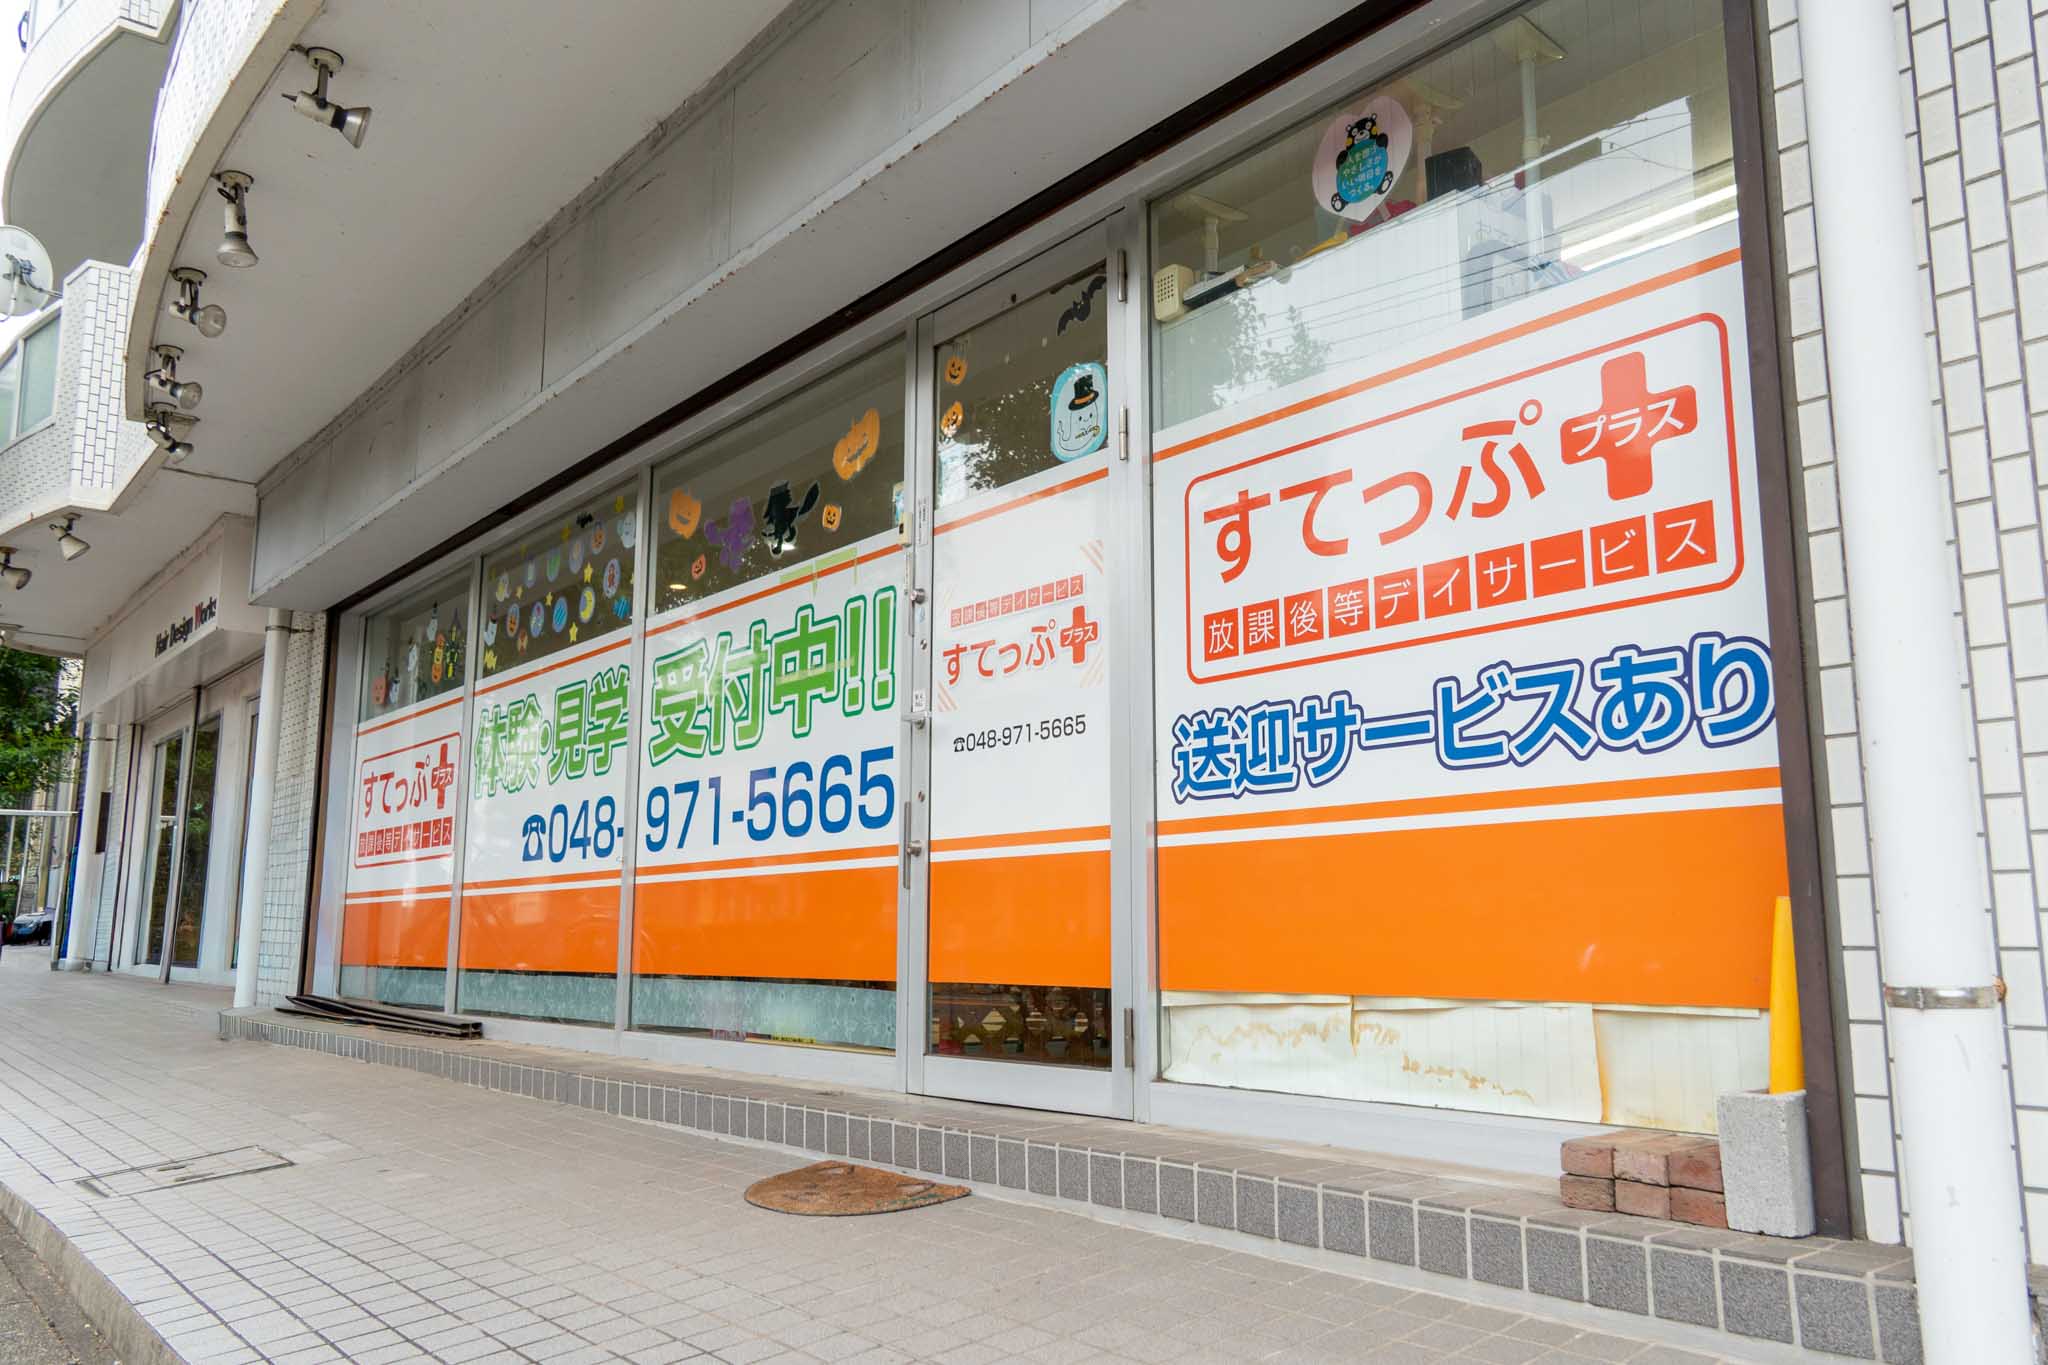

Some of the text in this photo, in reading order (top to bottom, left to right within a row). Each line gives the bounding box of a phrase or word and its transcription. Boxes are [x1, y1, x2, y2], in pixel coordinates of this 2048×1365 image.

[1203, 398, 1685, 583] すてっぷ プラス
[1206, 515, 1710, 658] 放課後等デイサービス
[943, 618, 1096, 685] すてっぷ プラス
[474, 664, 630, 799] 体験・見学
[966, 714, 1086, 751] 048-971-5665
[1172, 631, 1776, 801] 送迎サービスあり
[363, 754, 453, 818] すてっぷ プラス
[645, 746, 895, 852] 971-5665
